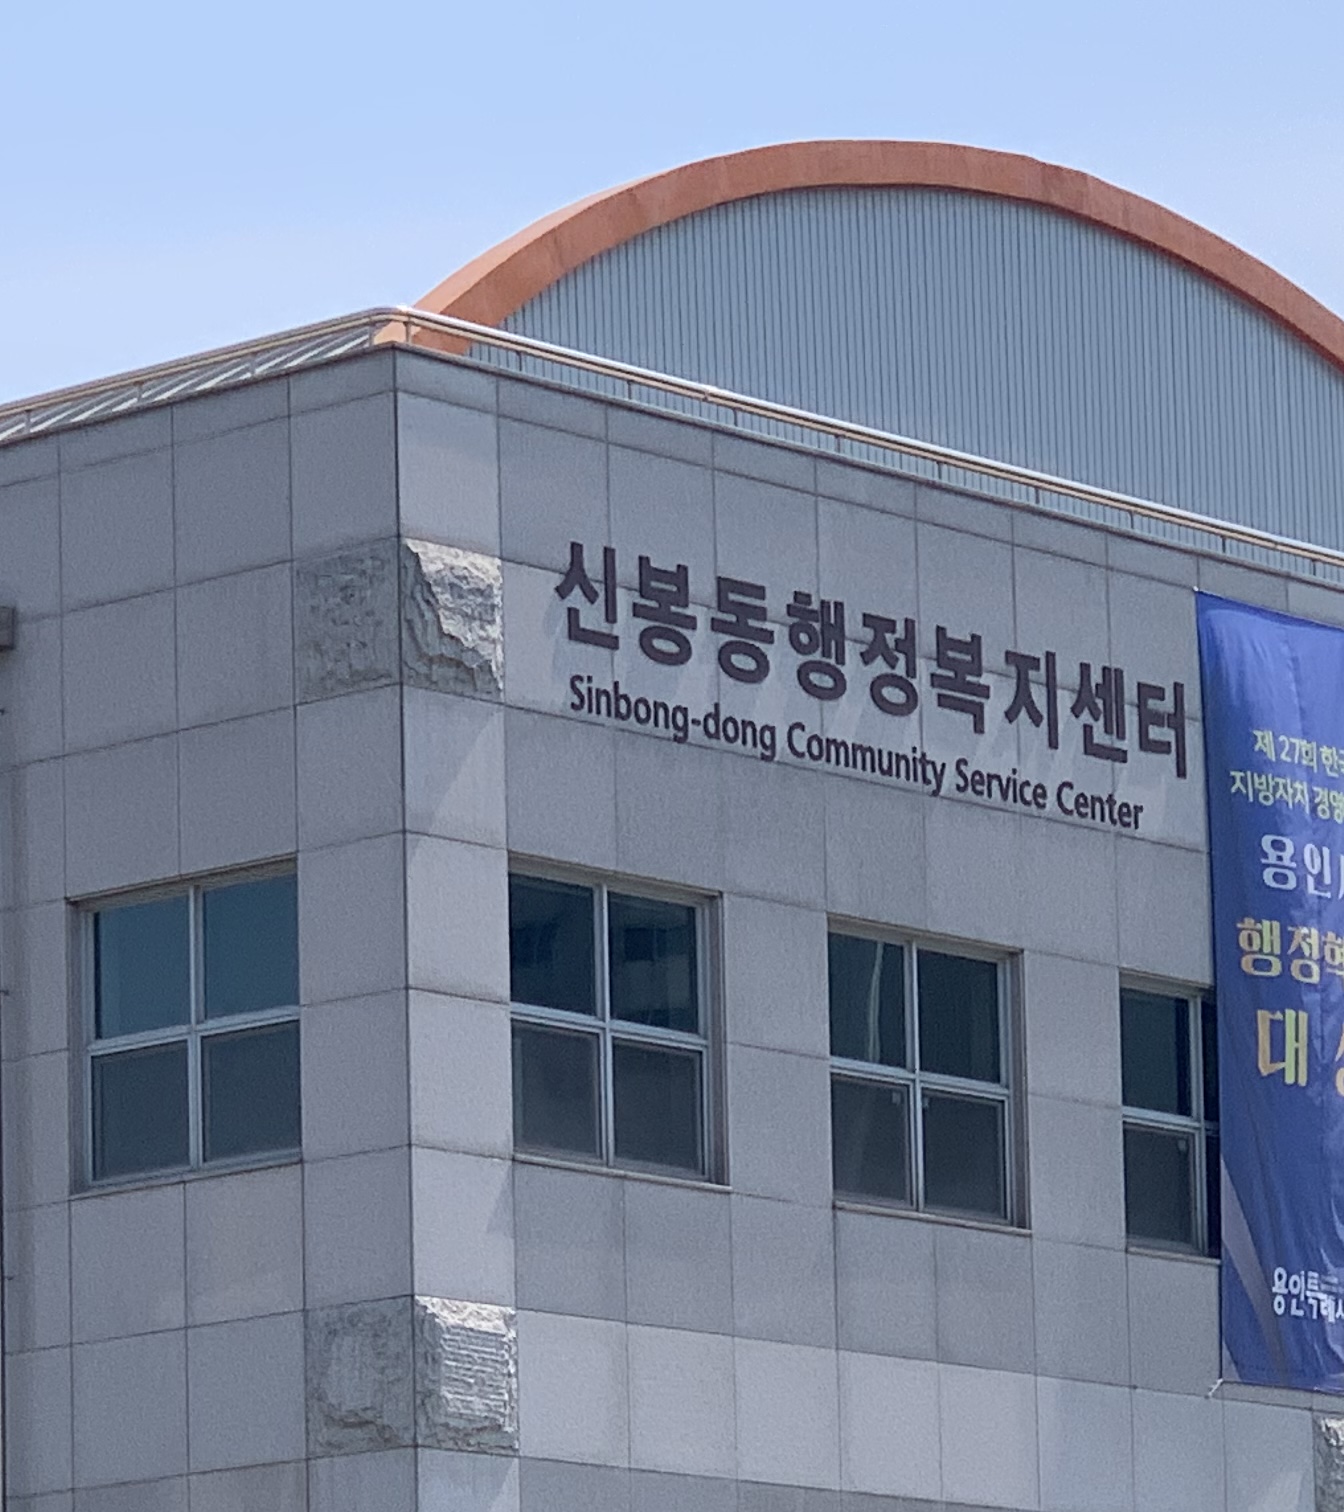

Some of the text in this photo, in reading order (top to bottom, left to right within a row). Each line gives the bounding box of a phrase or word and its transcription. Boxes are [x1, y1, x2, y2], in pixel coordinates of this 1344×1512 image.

[554, 541, 1187, 778] 신봉동행정복지센터
[569, 674, 1144, 830] Sinbong-dong Community Service Center
[1229, 770, 1310, 815] 지방자치
[1253, 729, 1276, 762] 제
[1278, 734, 1318, 774] 27회
